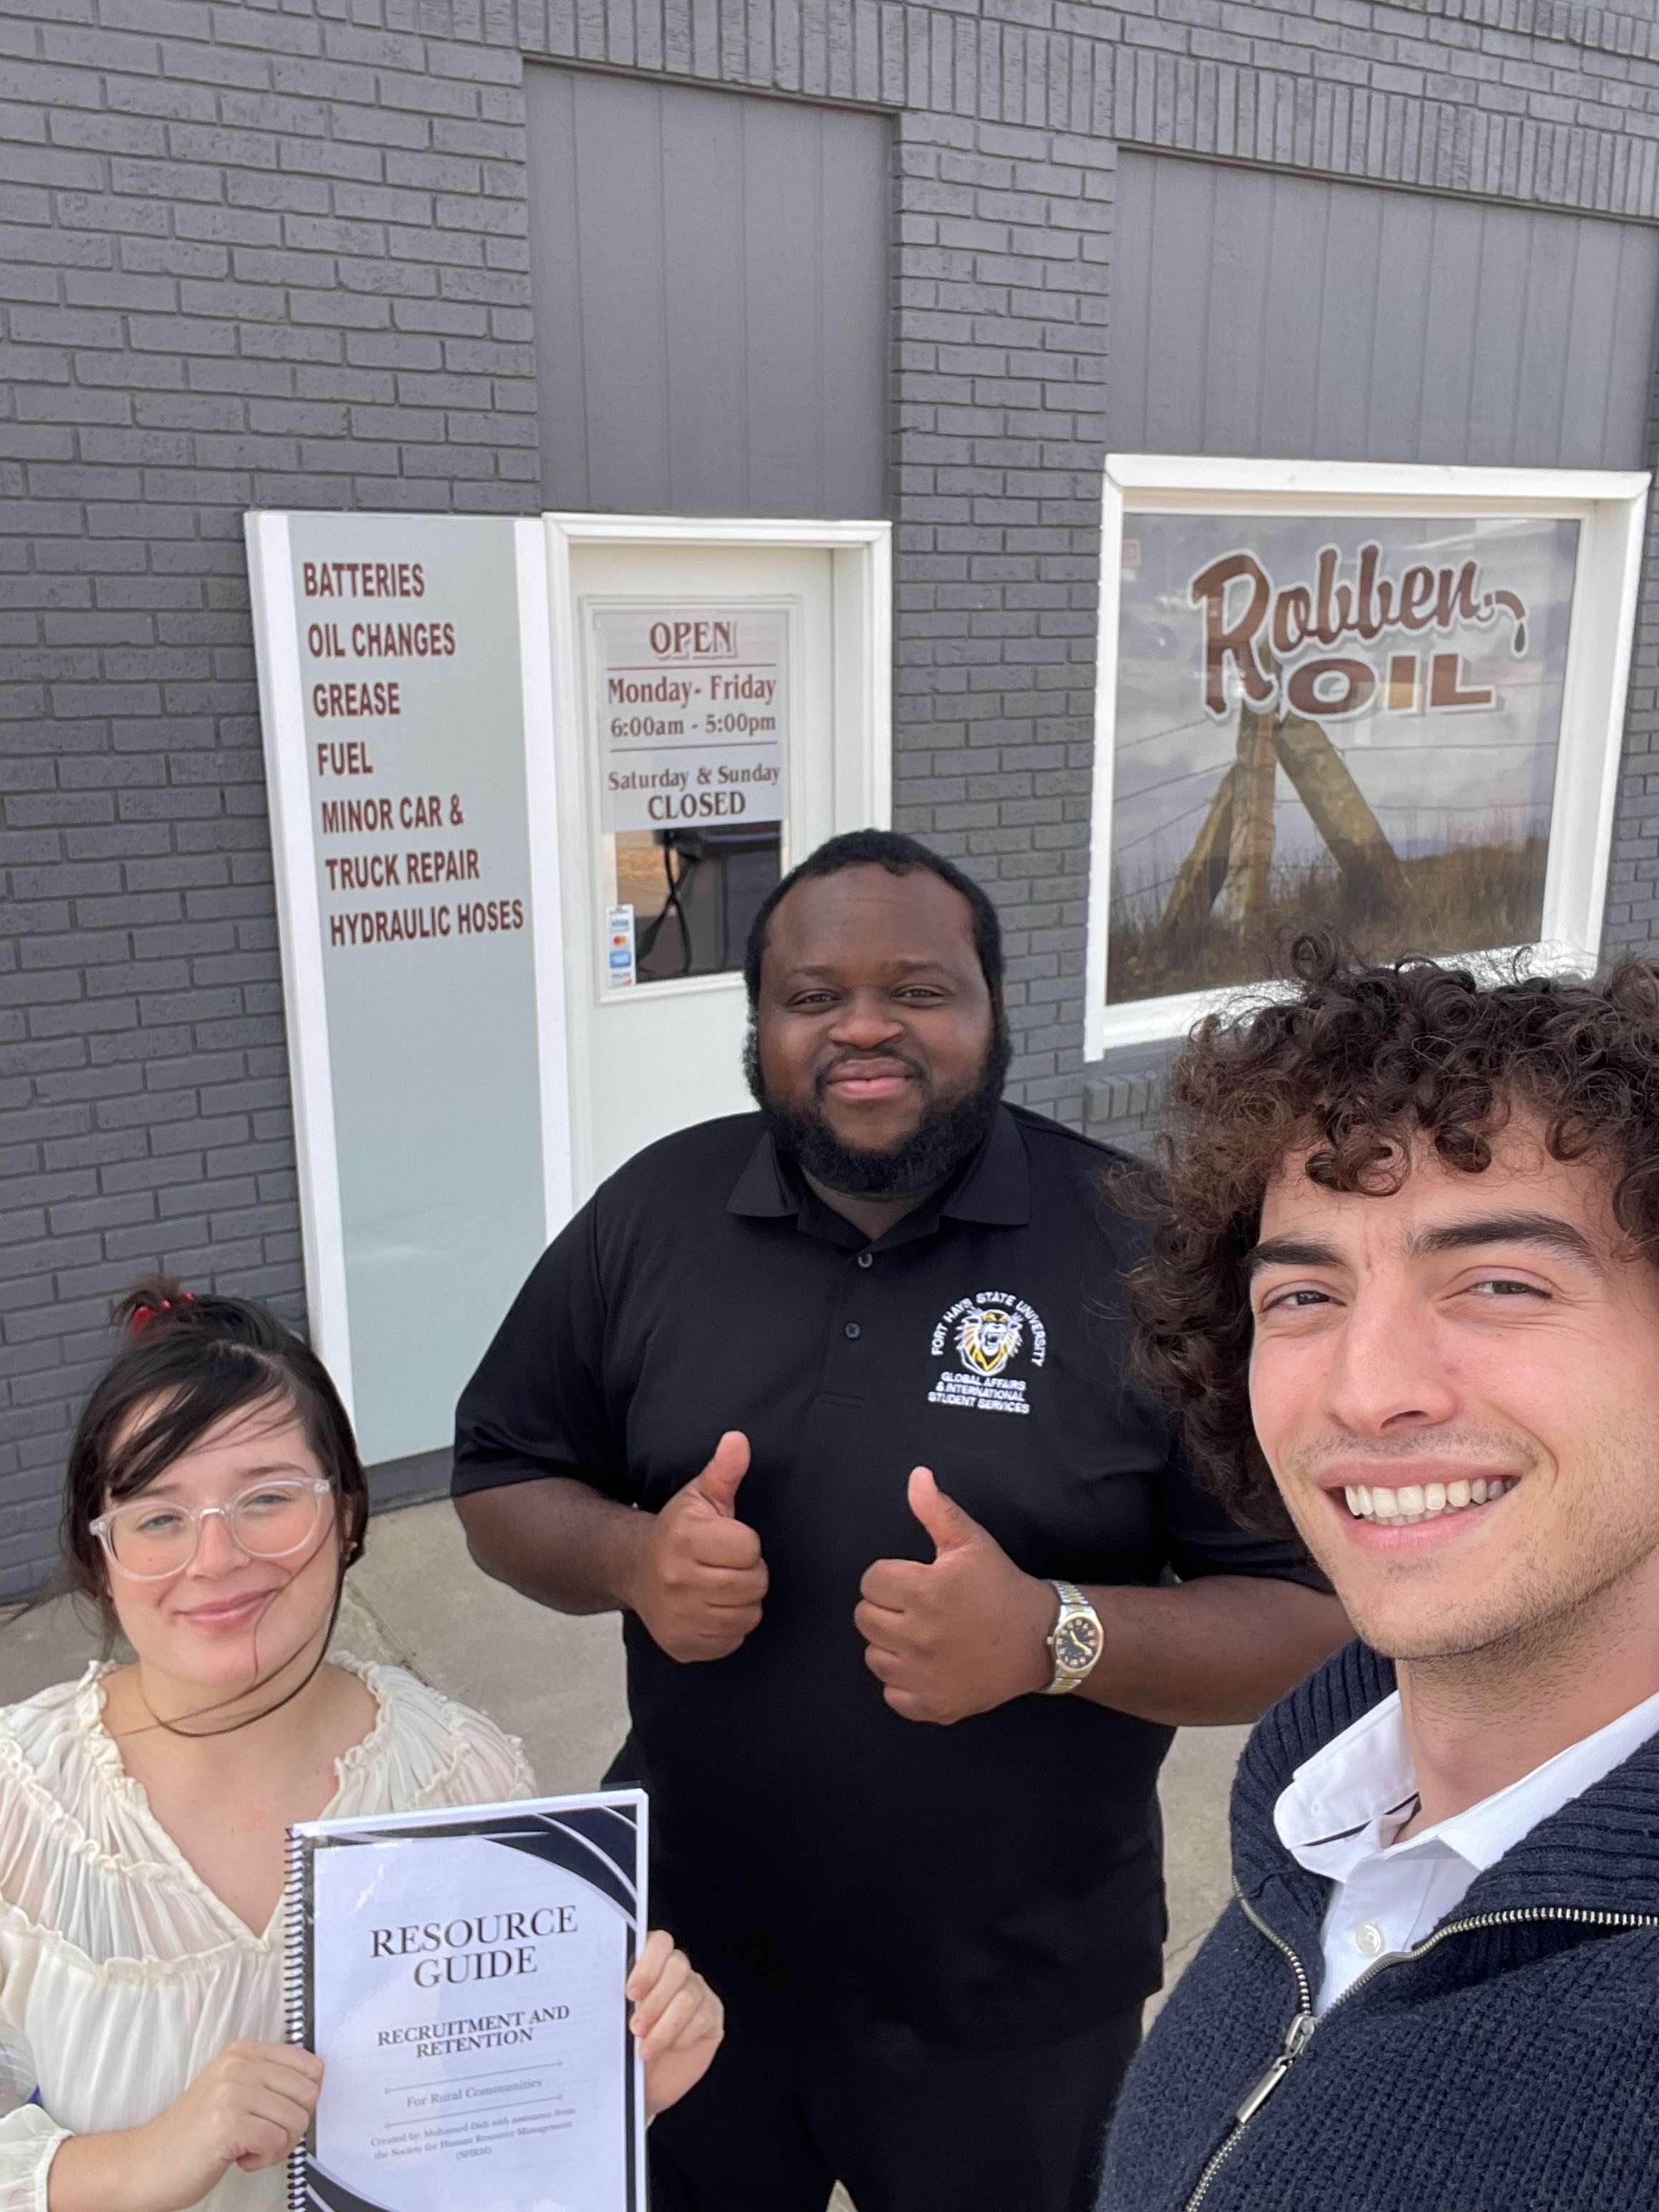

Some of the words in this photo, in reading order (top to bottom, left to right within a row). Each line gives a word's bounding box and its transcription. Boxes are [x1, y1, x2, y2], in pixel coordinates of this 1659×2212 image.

[303, 562, 425, 597] BATTERIES
[308, 622, 345, 658] OIL
[352, 622, 456, 657] CHANGES
[650, 621, 734, 656] OPEN
[1189, 542, 1490, 720] Robben
[313, 682, 401, 717] GREASE
[710, 673, 776, 706] Friday
[1287, 653, 1494, 716] OIL
[611, 716, 684, 738] 6:00am
[705, 713, 776, 736] 5:00pm
[317, 741, 373, 776] FUEL
[608, 768, 689, 792] Saturday
[697, 766, 712, 785] &
[718, 763, 781, 786] Sunday
[322, 797, 394, 834] MINOR
[400, 795, 443, 829] CAR
[449, 793, 463, 826] &
[648, 791, 746, 821] CLOSED
[325, 853, 400, 890] TRUCK
[406, 848, 480, 885] REPAIR
[330, 905, 451, 946] HYDRAULIC
[457, 899, 524, 935] HOSES
[931, 1322, 948, 1356] FORT
[976, 1291, 1016, 1307] STATE
[1015, 1300, 1047, 1367] UNIVERSITY
[941, 1371, 981, 1386] GLOBAL
[984, 1377, 1026, 1391] AFFAIRS
[946, 1382, 1026, 1402] INTERNATIONAL
[928, 1391, 976, 1407] STUDENT
[977, 1398, 1030, 1415] SERVICES
[370, 1905, 578, 1958] RESOURCE
[413, 1945, 538, 1989] GUIDE
[378, 2011, 526, 2047] RECRUITMENT
[529, 2005, 570, 2025] AND
[416, 2027, 534, 2059] RETENTION
[406, 2095, 426, 2108] For
[431, 2089, 462, 2105] Rural
[466, 2077, 542, 2099] Communities
